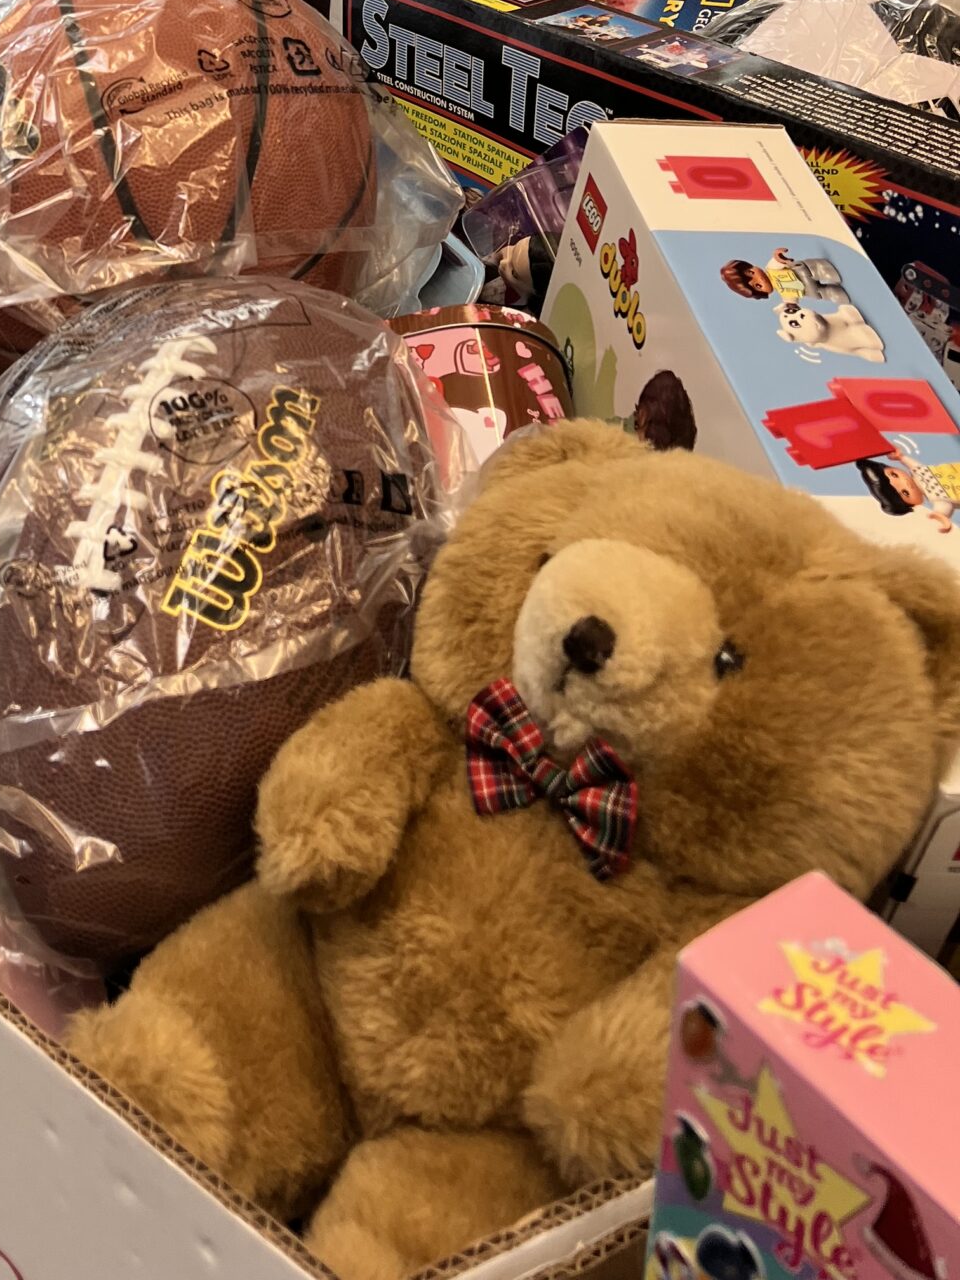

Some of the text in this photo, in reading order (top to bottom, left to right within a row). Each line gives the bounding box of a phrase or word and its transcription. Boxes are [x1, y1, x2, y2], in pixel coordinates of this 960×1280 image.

[692, 9, 711, 32] GEO
[141, 82, 183, 104] Standard
[191, 96, 214, 112] bag
[377, 72, 475, 122] STEEL CONSTRUCTION SYSTEM
[411, 107, 447, 130] FREEDOM
[453, 128, 485, 148] STATION
[487, 144, 521, 167] SPATIALE
[429, 128, 467, 151] STAZIONE
[468, 146, 504, 169] SPAZIALE
[461, 152, 495, 175] VRIJHEID
[582, 192, 603, 235] LEGO
[600, 242, 647, 350] duplo
[810, 956, 898, 1010] Just
[771, 982, 893, 1059] Style
[727, 1090, 824, 1181] Just
[720, 1152, 855, 1271] Style
